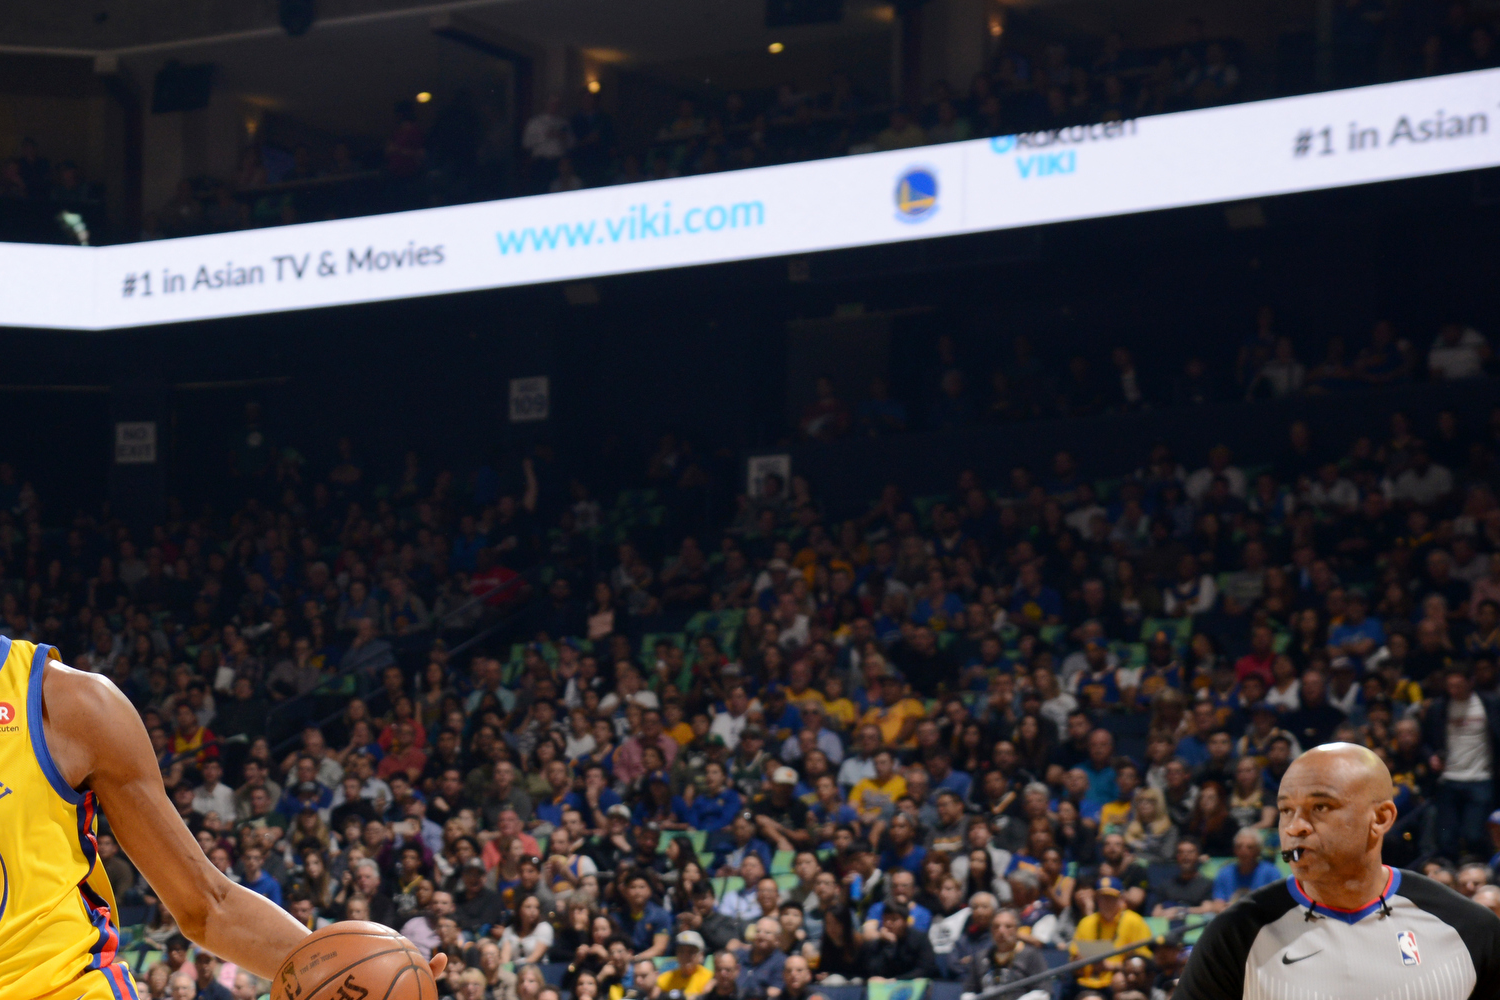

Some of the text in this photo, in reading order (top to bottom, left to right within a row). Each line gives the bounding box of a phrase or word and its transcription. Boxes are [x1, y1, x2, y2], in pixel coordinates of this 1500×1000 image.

[1293, 109, 1489, 158] #1 in Asian
[1016, 150, 1077, 179] VIKI
[496, 200, 766, 256] www.viki.com
[122, 240, 445, 298] #1 in Asian TV & Movies
